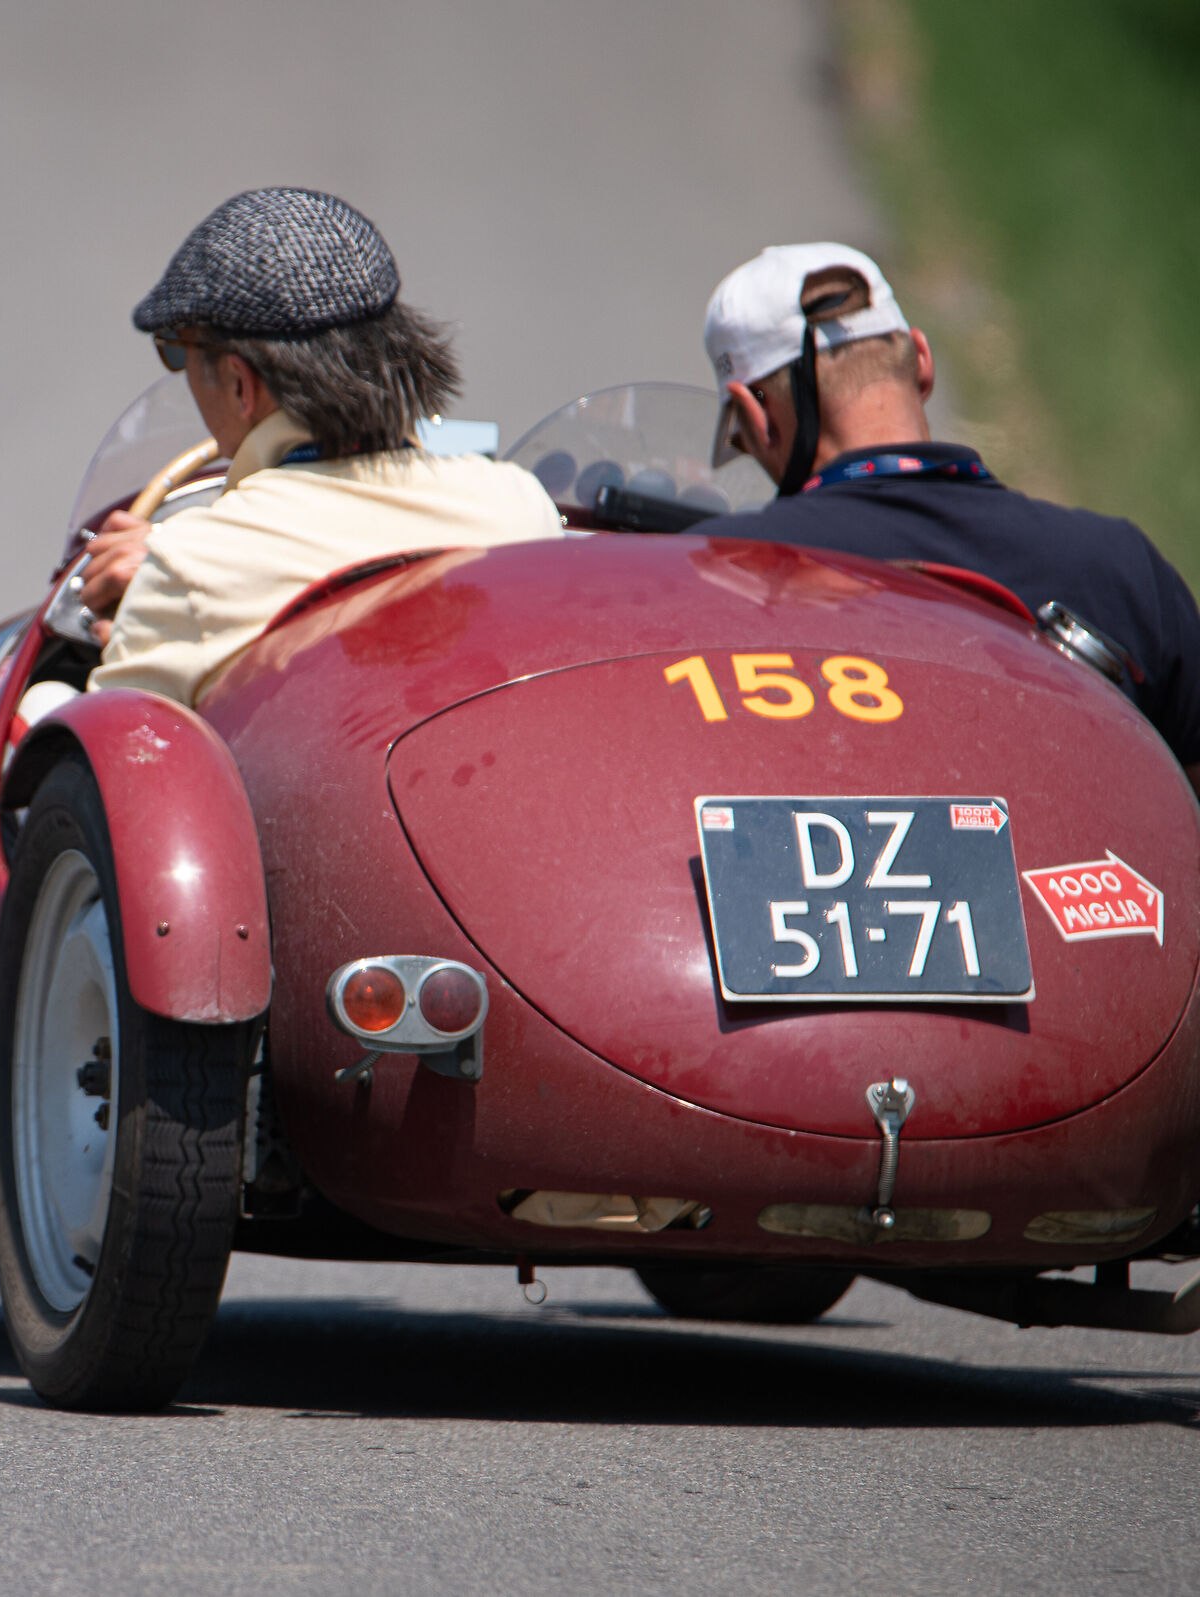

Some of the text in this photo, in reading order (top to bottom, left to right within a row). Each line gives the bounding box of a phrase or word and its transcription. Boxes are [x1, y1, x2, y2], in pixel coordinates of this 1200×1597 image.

[663, 652, 905, 723] 158
[957, 816, 996, 826] MIGLIA
[959, 807, 992, 817] 1000
[792, 811, 932, 889] DZ
[1048, 870, 1122, 899] 1000
[1063, 899, 1147, 929] MIGLIA
[770, 900, 981, 978] 51-71
